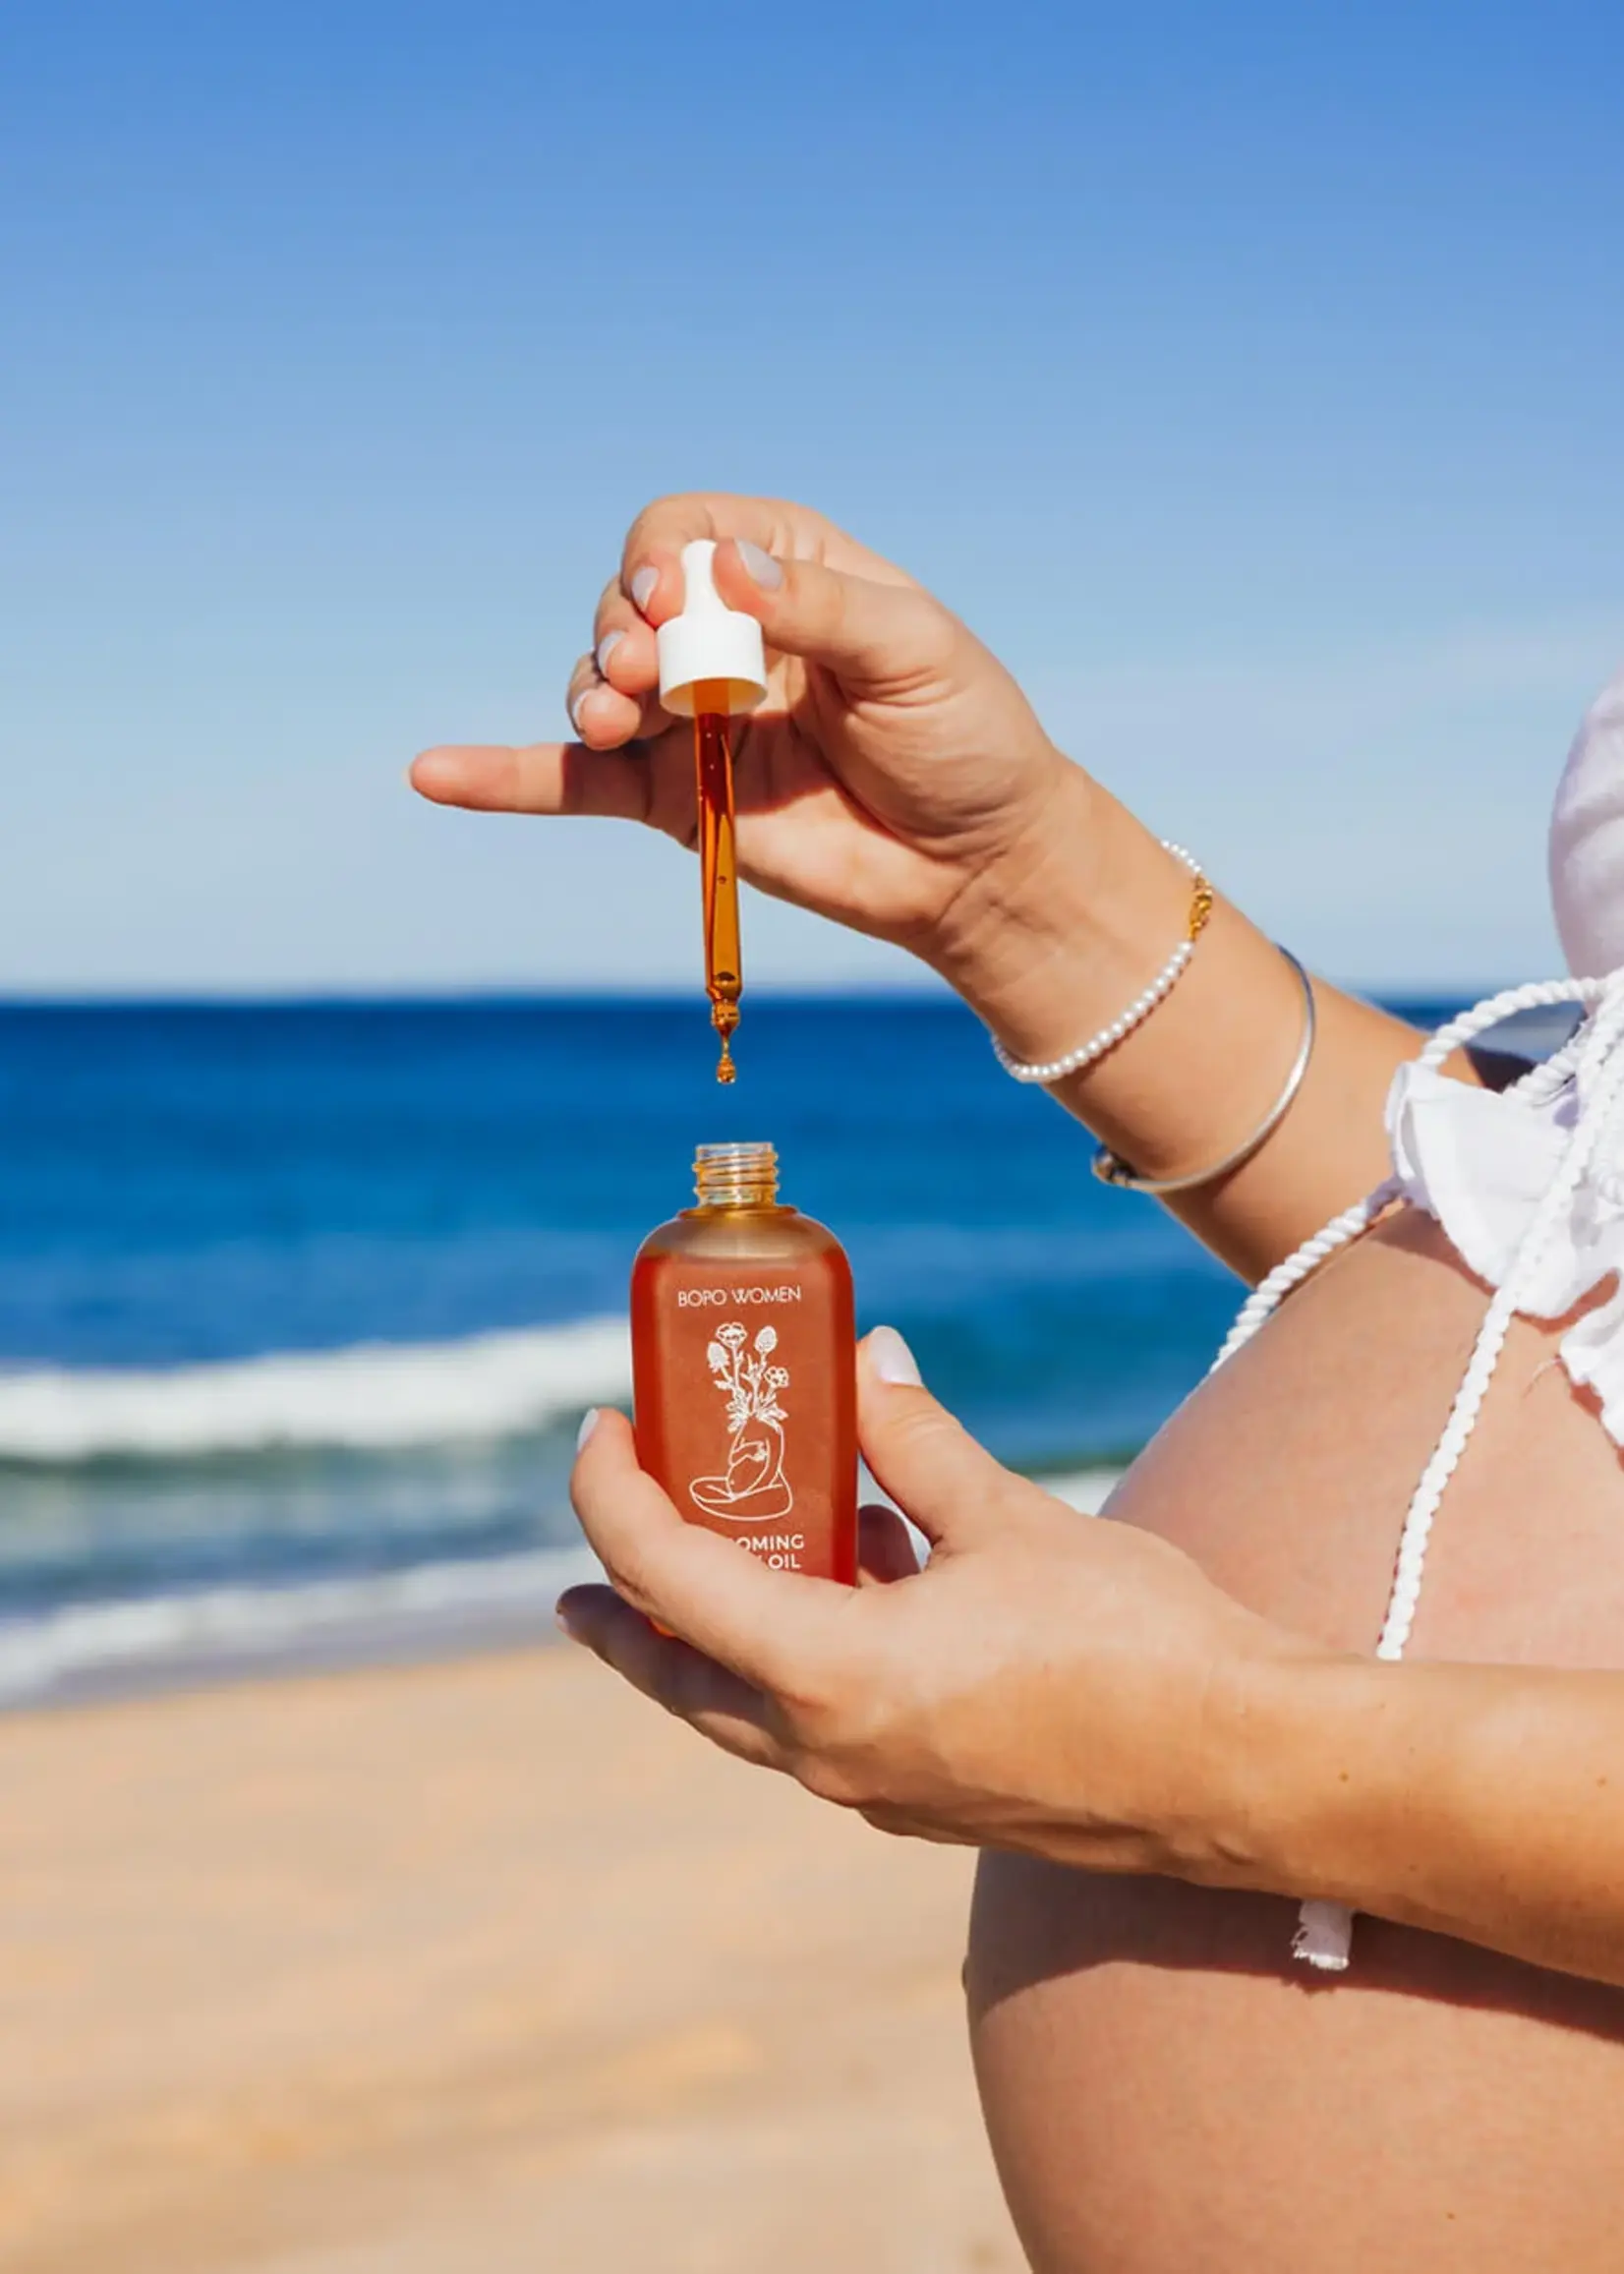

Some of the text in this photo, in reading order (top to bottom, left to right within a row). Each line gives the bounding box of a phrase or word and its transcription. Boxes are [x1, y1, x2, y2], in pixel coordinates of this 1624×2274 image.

[677, 1284, 802, 1308] BOPO WOMEN
[735, 1534, 805, 1551] OMING
[768, 1553, 801, 1570] OIL
